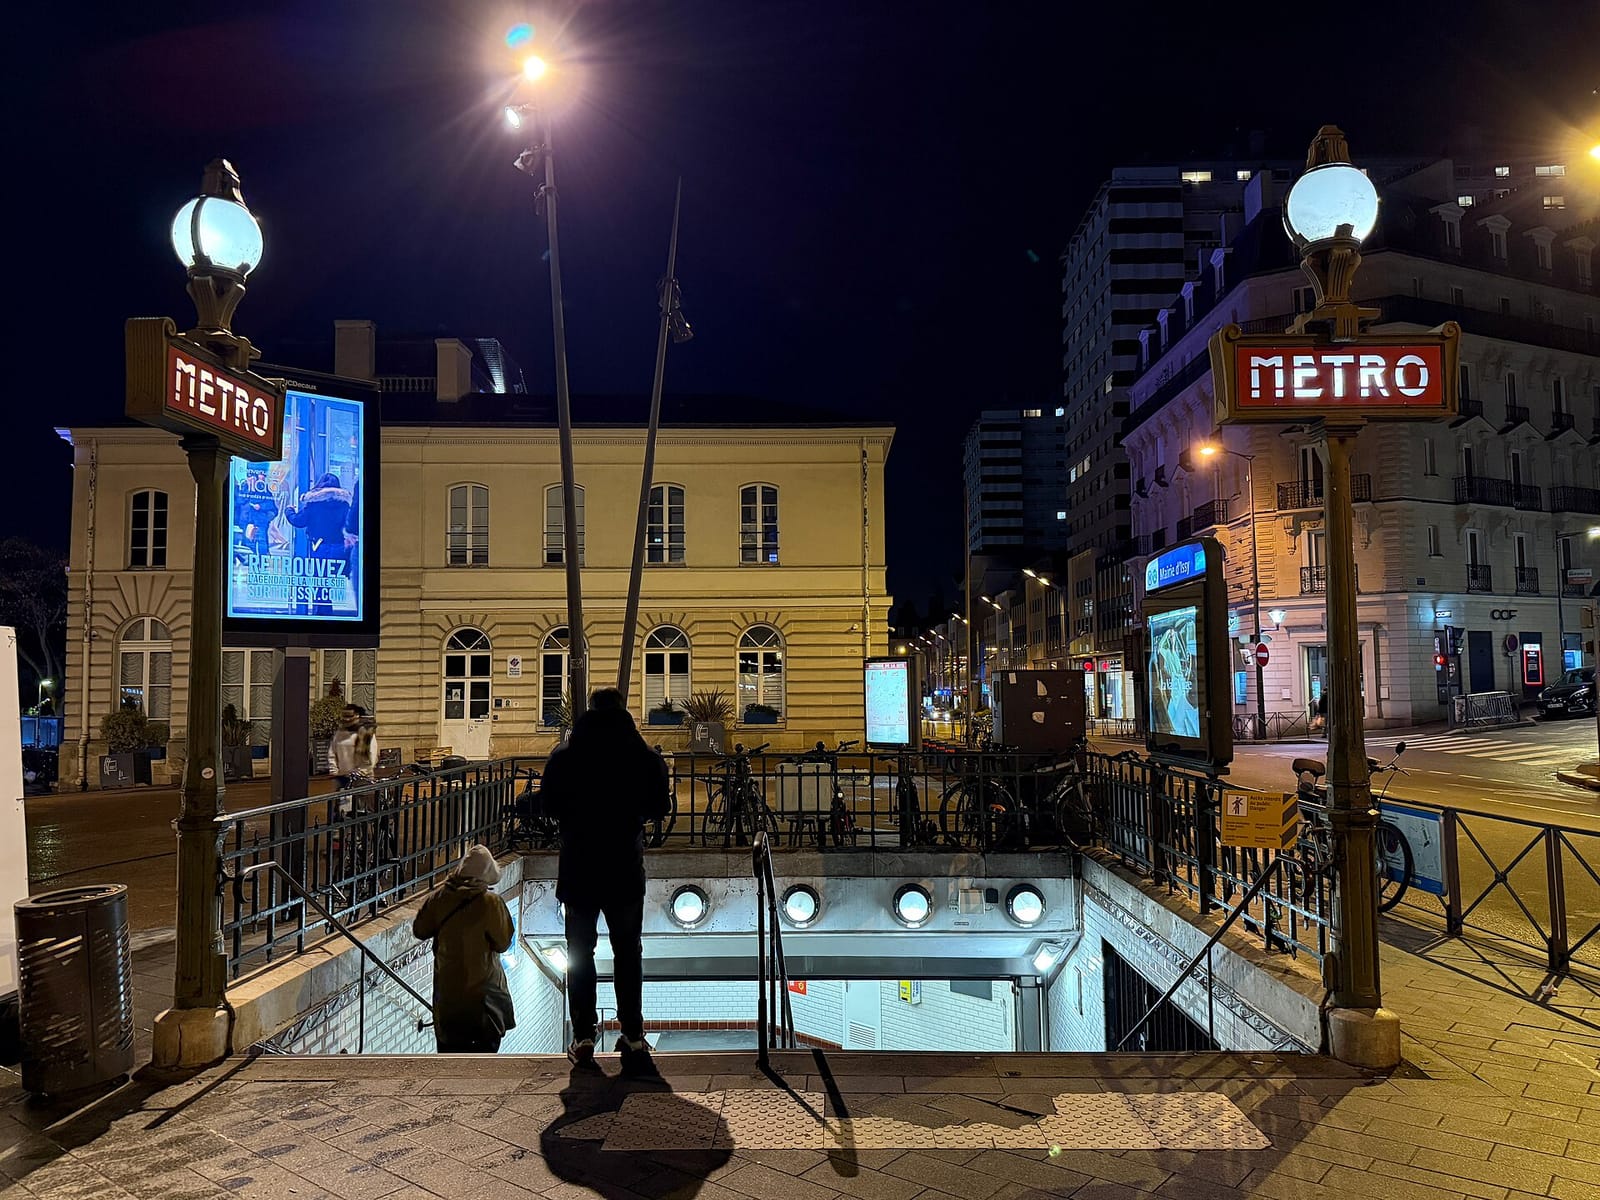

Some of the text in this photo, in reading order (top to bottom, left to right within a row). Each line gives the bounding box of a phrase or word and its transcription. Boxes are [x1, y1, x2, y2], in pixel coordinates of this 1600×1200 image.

[1250, 354, 1429, 398] METRO
[175, 357, 269, 437] METRO
[248, 554, 346, 578] RETROUVEZ
[1160, 564, 1175, 580] Mairie
[1176, 561, 1190, 576] d'Issy
[248, 574, 345, 588] L'AGENDA DE LA VILLE SUR
[1491, 608, 1518, 621] CCF
